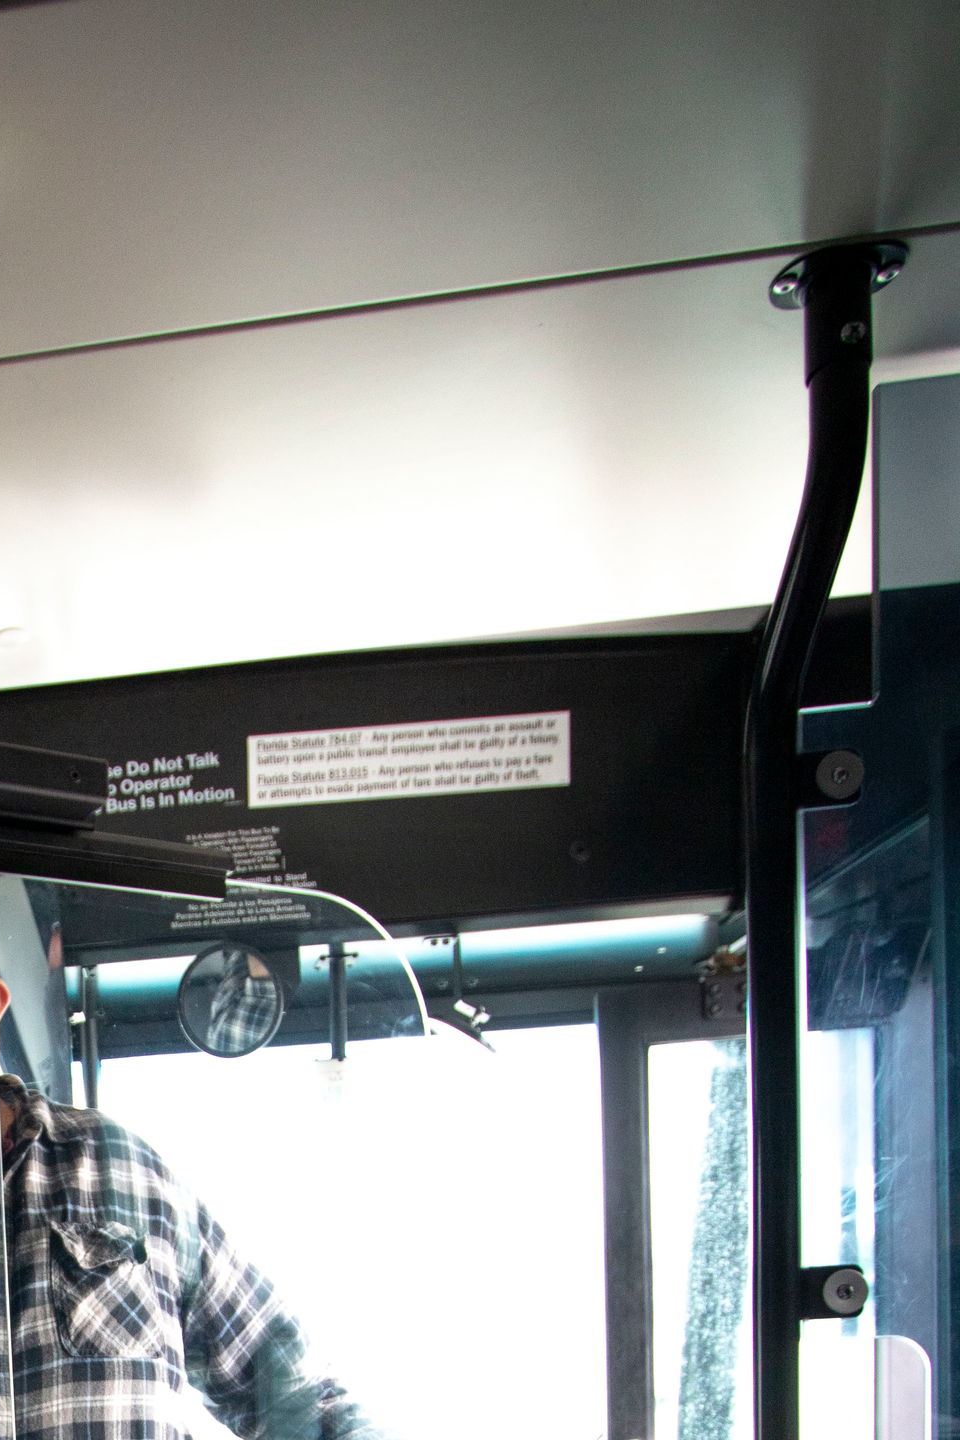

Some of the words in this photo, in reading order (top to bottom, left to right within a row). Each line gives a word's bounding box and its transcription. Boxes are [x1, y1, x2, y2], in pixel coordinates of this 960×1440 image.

[257, 740, 288, 750] Florida
[292, 736, 326, 747] Statute
[373, 731, 389, 742] Any
[392, 728, 423, 741] person
[428, 727, 445, 737] who
[450, 724, 490, 735] commits
[495, 723, 505, 732] an
[510, 720, 543, 731] assault
[547, 720, 556, 728] or
[258, 753, 289, 765] battery
[294, 753, 316, 763] upon
[327, 749, 354, 760] public
[359, 746, 388, 756] transit
[392, 742, 436, 756] employee
[440, 740, 460, 750] shall
[465, 739, 475, 748] be
[480, 736, 505, 750] guilty
[509, 736, 517, 745] of
[126, 761, 150, 776] Do
[154, 756, 183, 773] Not
[186, 752, 219, 769] Talk
[258, 773, 289, 784] Florida
[292, 770, 326, 781] Statute
[379, 765, 395, 776] Any
[398, 764, 430, 776] person
[435, 761, 453, 771] who
[456, 758, 490, 769] refuses
[494, 757, 502, 766] to
[507, 757, 522, 768] pay
[534, 754, 553, 764] fare
[120, 774, 192, 796] Operator
[258, 790, 266, 799] or
[271, 786, 312, 799] attempts
[315, 785, 323, 794] to
[327, 782, 354, 793] evade
[358, 780, 397, 792] payment
[401, 778, 410, 788] of
[413, 776, 431, 787] fare
[435, 774, 457, 785] shall
[460, 773, 471, 784] be
[475, 771, 499, 785] guilty
[503, 771, 512, 780] of
[106, 798, 136, 814] Bus
[141, 795, 155, 809] Is
[159, 792, 174, 807] In
[178, 787, 235, 805] Motion
[285, 872, 307, 881] Stand
[257, 898, 292, 906] Pasajeros
[269, 912, 311, 920] Movimiento
